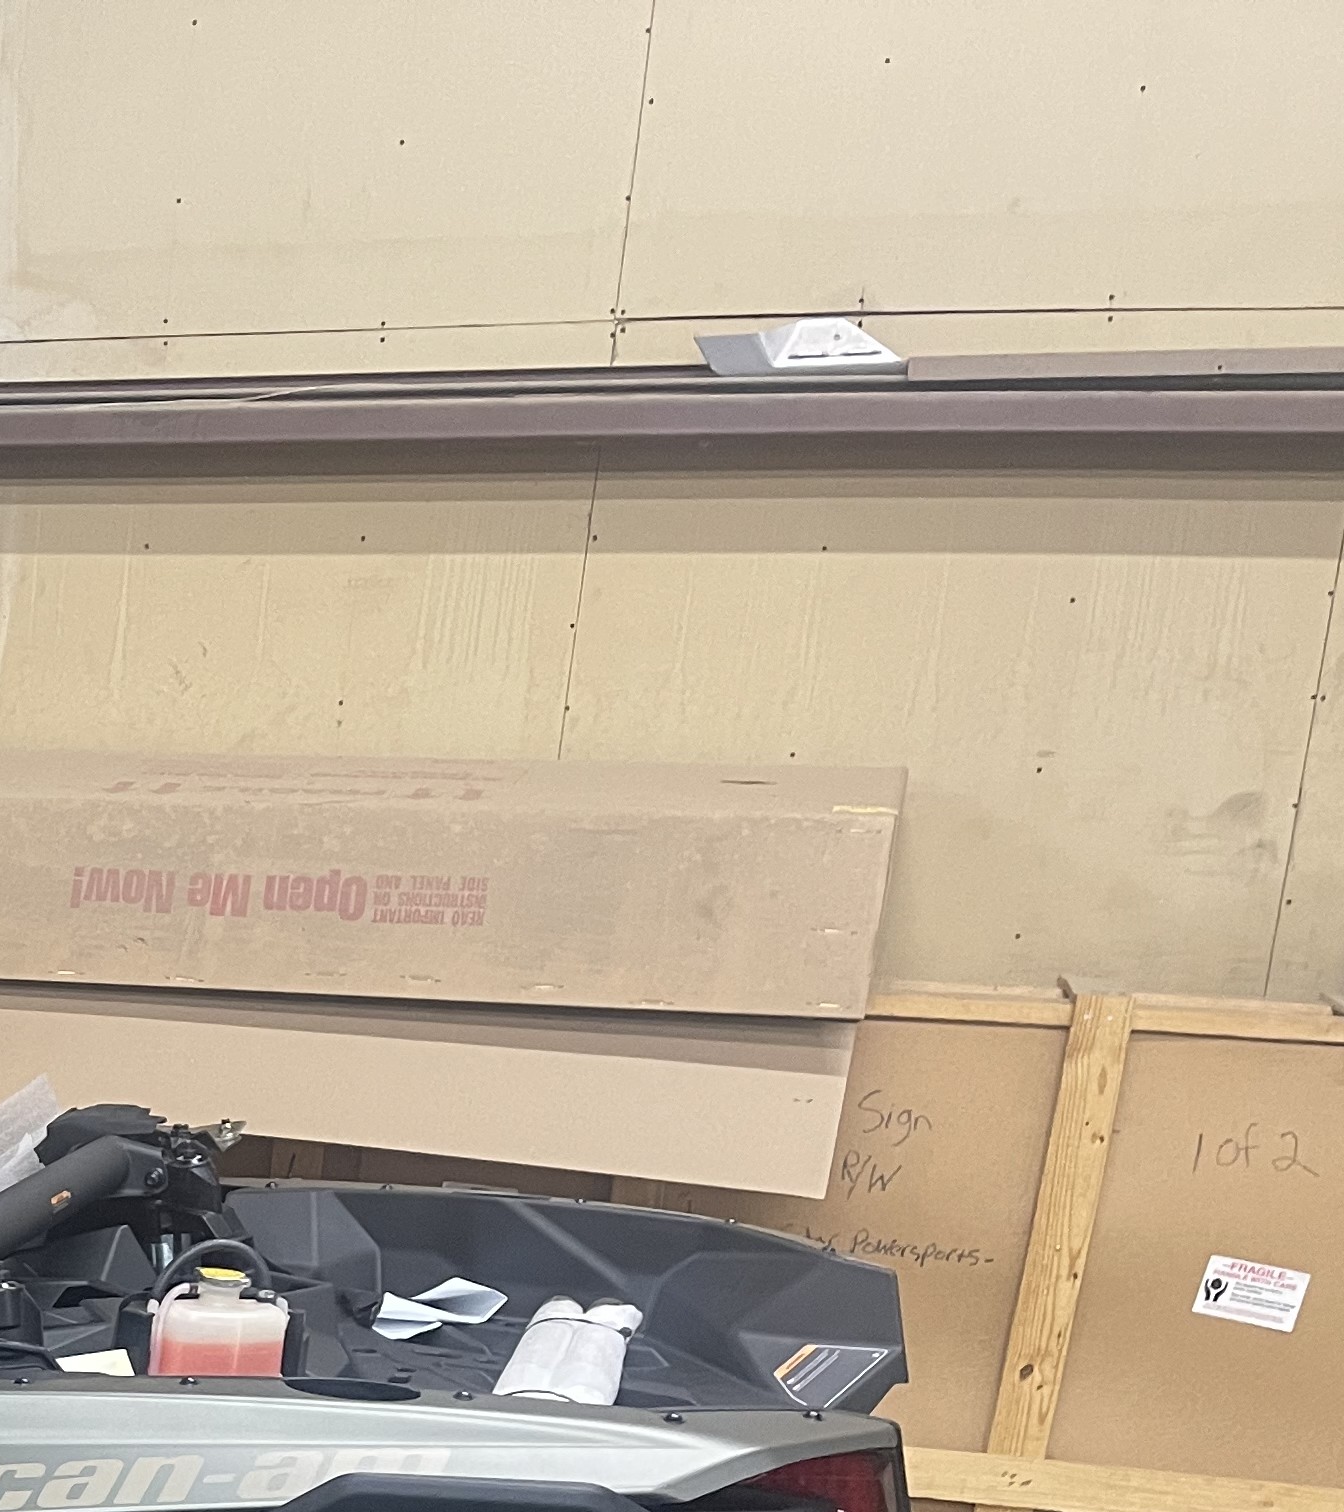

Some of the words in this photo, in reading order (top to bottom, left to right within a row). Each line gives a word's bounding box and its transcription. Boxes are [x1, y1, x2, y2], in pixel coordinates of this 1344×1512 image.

[69, 866, 177, 914] Now!
[187, 871, 252, 918] Me
[263, 868, 369, 921] Open
[410, 875, 451, 891] PANEL
[458, 877, 489, 892] SIDE
[370, 908, 445, 926] IMPORTANT
[857, 1089, 932, 1147] Sign
[1215, 1122, 1260, 1168] of
[1271, 1130, 1320, 1177] 2
